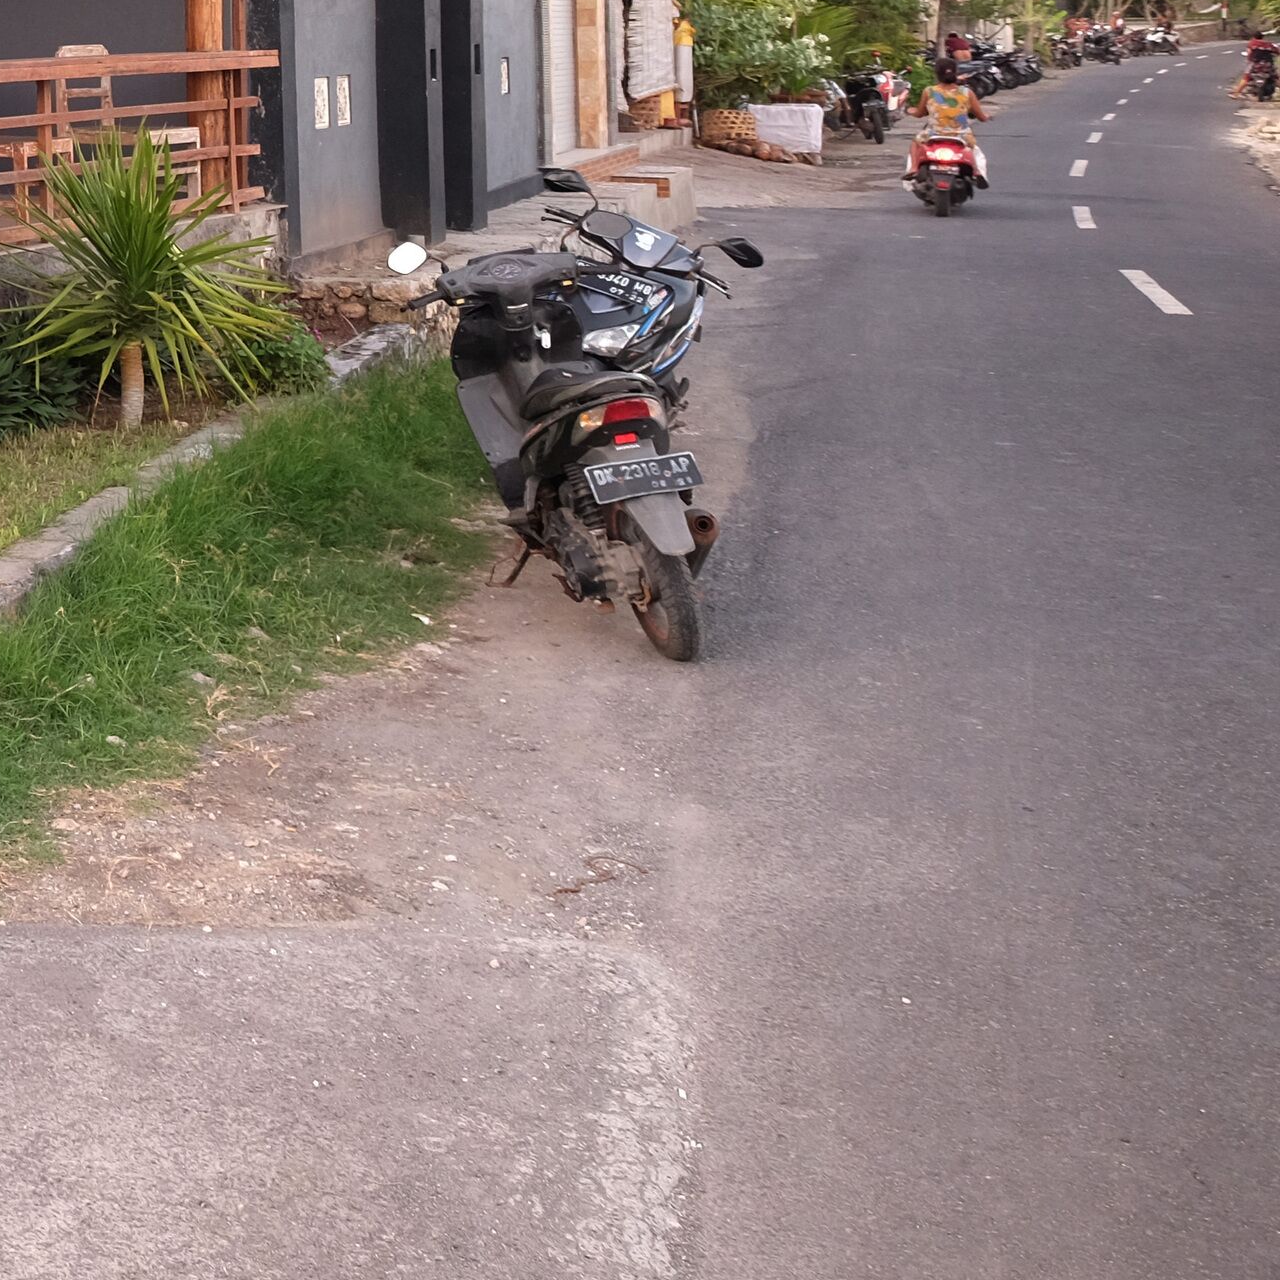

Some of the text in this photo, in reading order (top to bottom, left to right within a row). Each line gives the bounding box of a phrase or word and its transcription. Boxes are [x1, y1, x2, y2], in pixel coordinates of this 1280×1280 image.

[593, 457, 689, 486] DK 2318 AP
